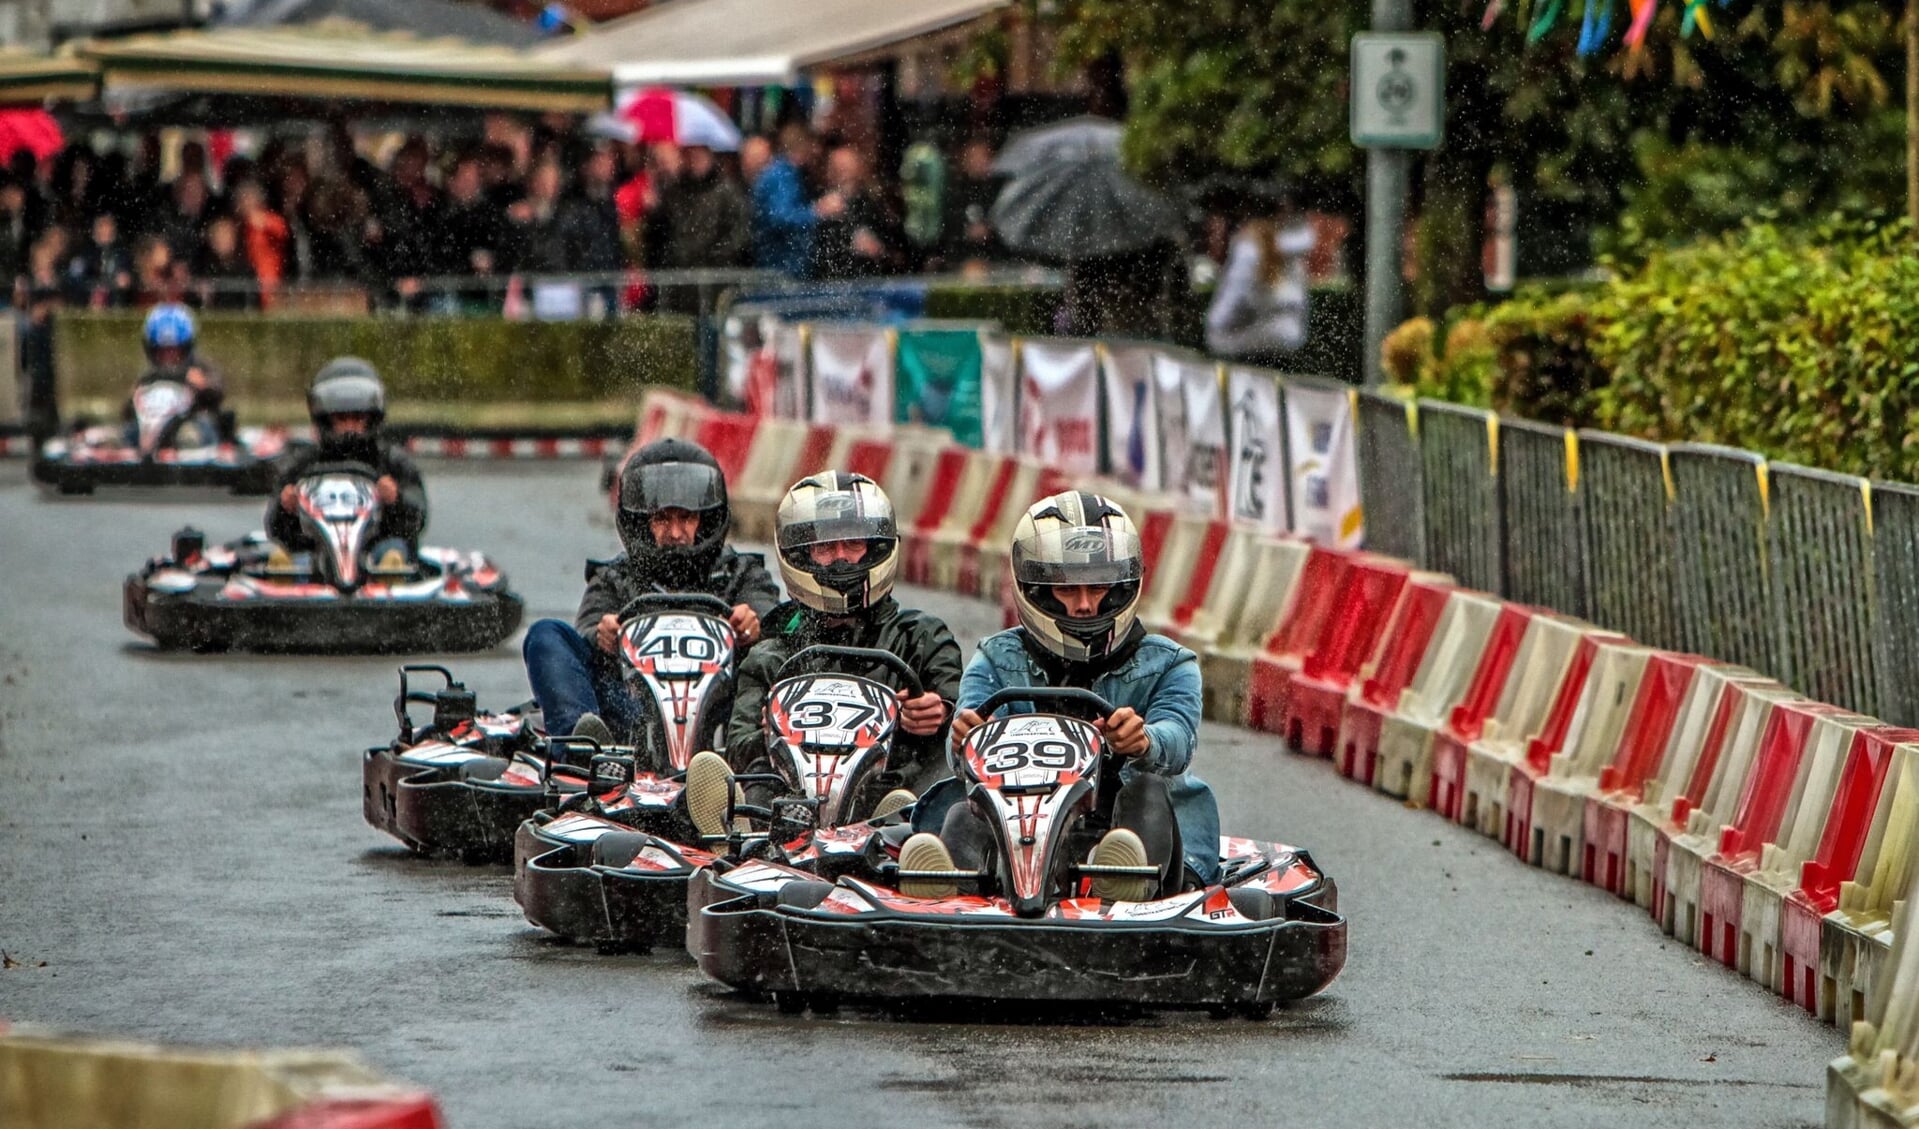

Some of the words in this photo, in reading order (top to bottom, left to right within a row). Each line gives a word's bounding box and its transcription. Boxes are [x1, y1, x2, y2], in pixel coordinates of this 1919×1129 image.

[638, 635, 716, 661] 40
[791, 701, 876, 729] 37
[985, 741, 1076, 773] 39
[1210, 908, 1236, 920] GTR
